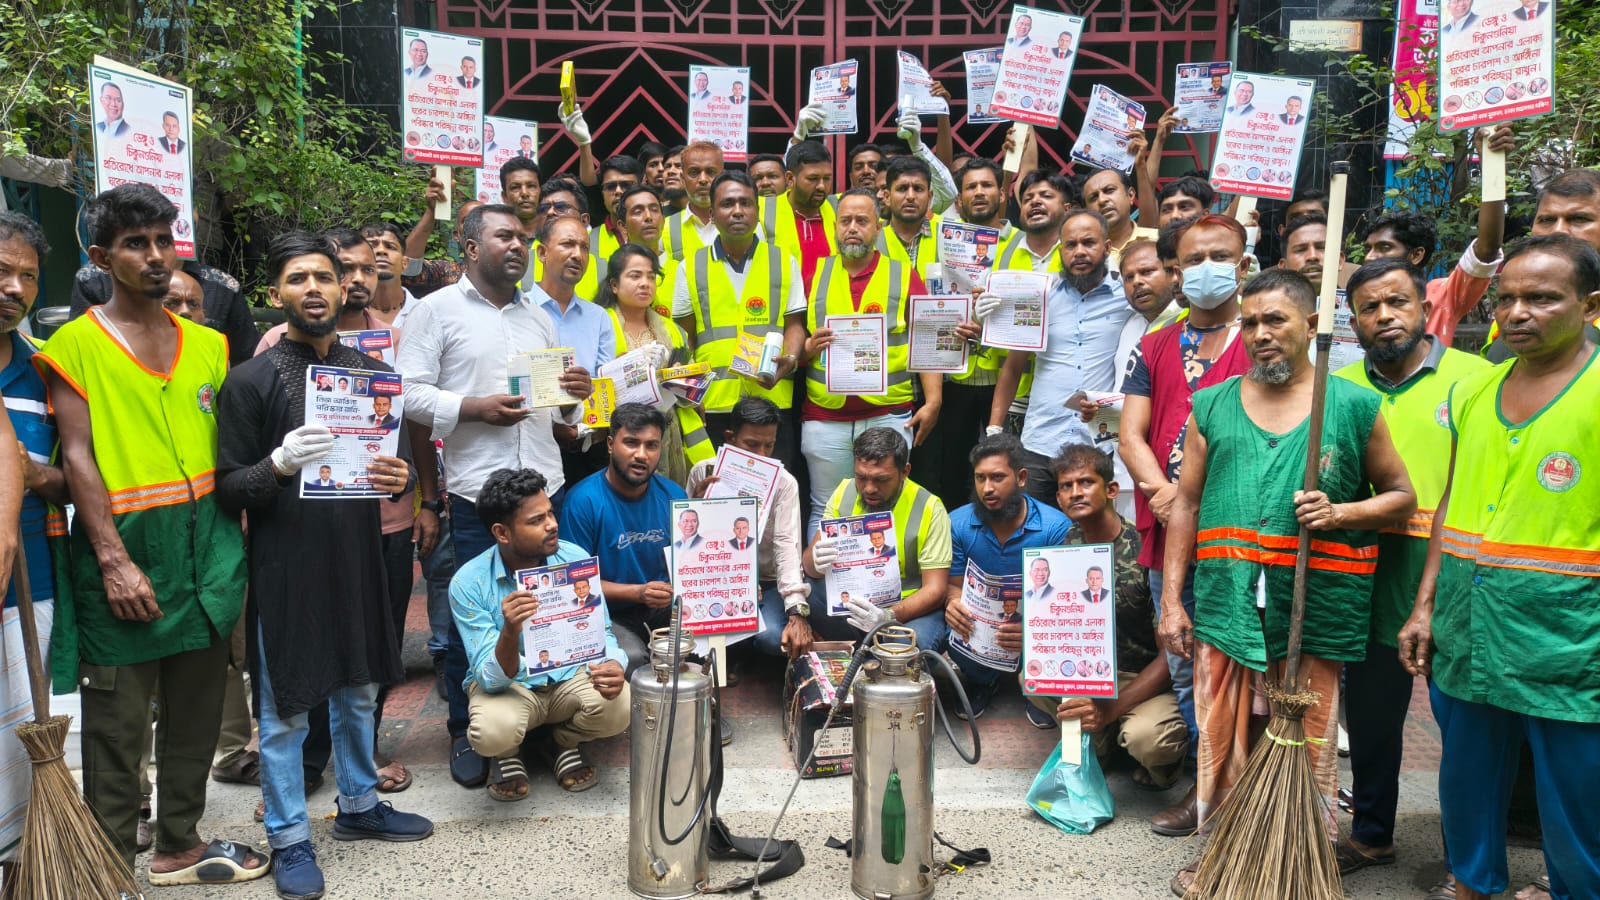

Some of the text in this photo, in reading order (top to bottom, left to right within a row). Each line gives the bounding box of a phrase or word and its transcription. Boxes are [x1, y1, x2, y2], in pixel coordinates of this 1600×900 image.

[1481, 16, 1498, 26] ডেঙ্গু
[1445, 34, 1542, 62] প্রতিরোধে আপনার এলাকা
[1449, 64, 1469, 75] ঘরের
[1472, 57, 1501, 69] চারপাশ
